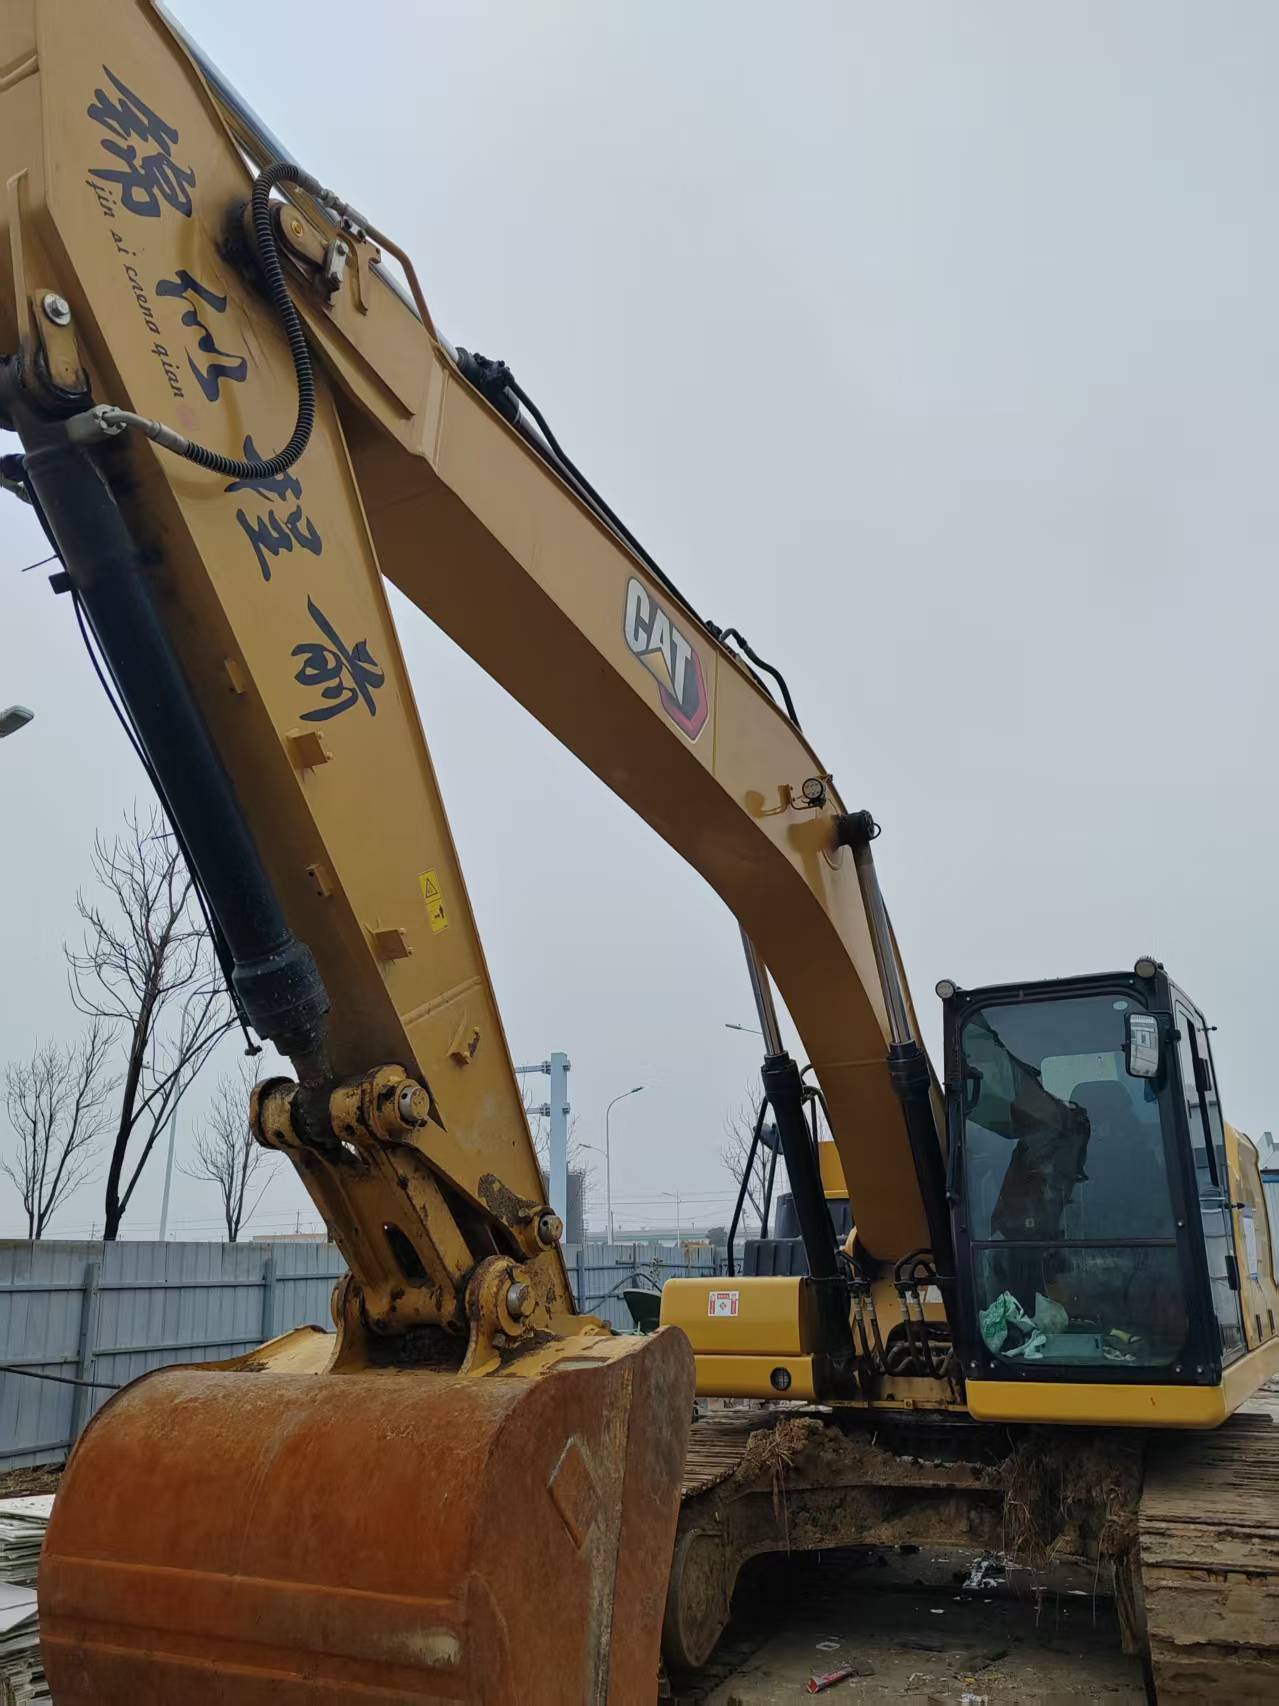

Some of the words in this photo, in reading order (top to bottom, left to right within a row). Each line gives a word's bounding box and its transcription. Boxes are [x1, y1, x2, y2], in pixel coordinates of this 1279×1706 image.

[85, 180, 117, 218] jin
[152, 342, 185, 398] qian
[624, 577, 692, 705] CAT
